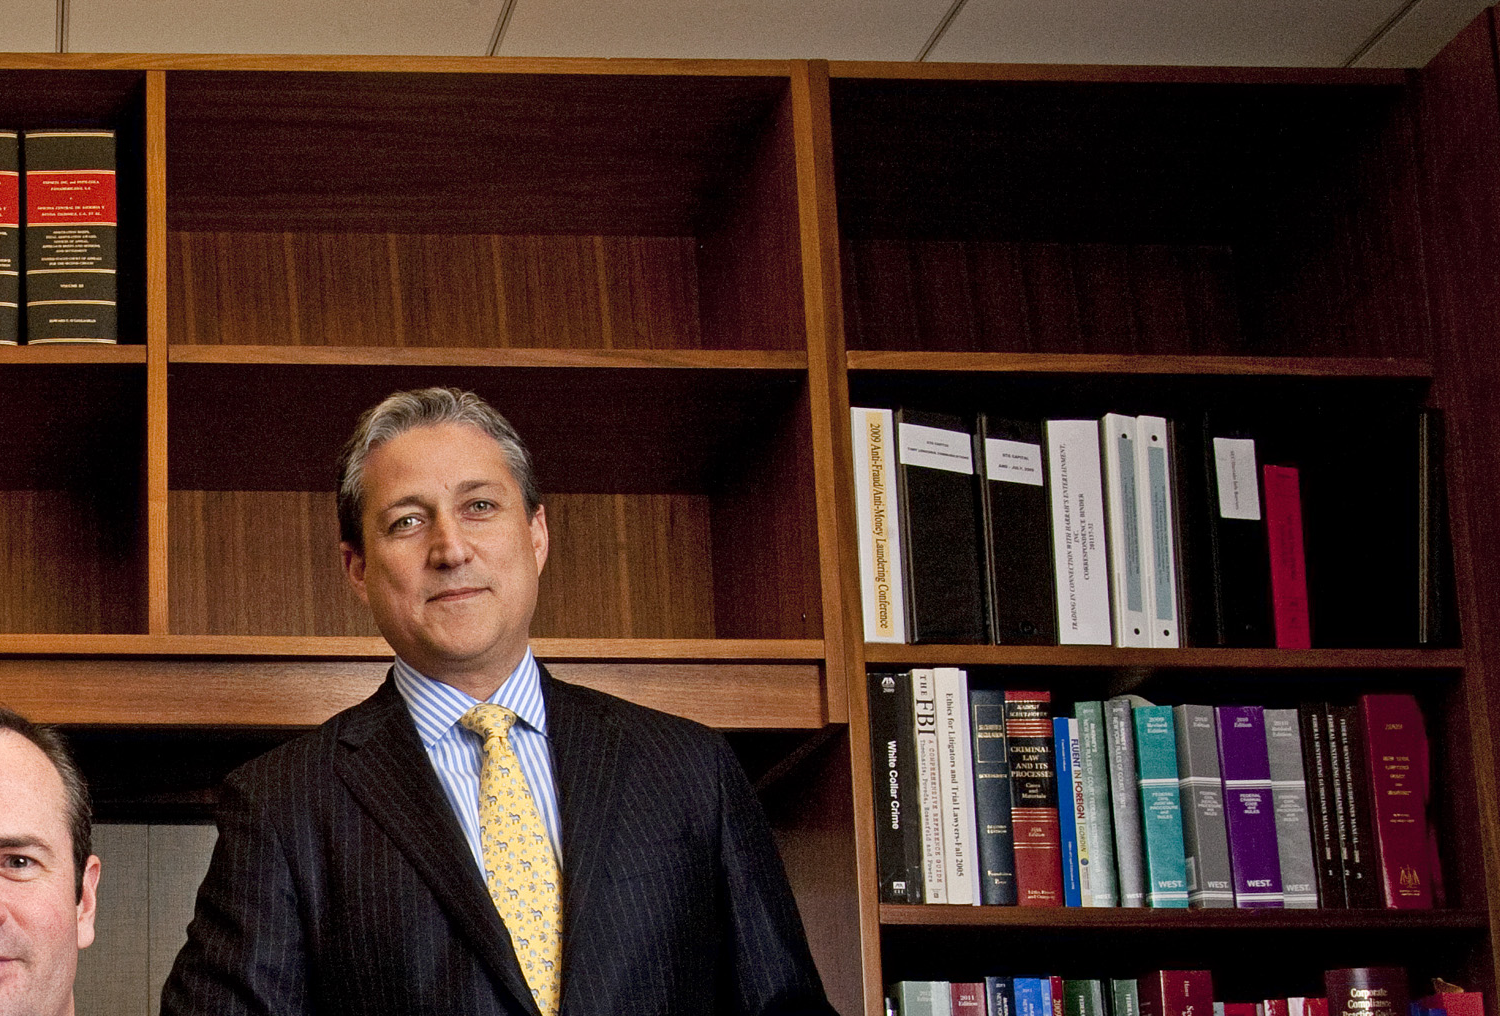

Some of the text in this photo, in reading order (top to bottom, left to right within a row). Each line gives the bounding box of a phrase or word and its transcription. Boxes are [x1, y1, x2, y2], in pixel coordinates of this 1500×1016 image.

[870, 423, 890, 629] 2009 Anti-Fraud/Anti-Money Laundering Conference
[1080, 519, 1090, 580] CORRESPONDENCE
[1067, 551, 1075, 592] CONNECTION
[1070, 602, 1078, 630] TRADING
[916, 675, 935, 736] THE FBI
[887, 741, 900, 829] White Collar Crime
[929, 748, 938, 809] COMPREHENSIVE
[946, 693, 964, 876] Ethics for Litigators and Trial Lawyers-Fall 2005
[1071, 739, 1085, 819] FLUENT IN FOREIGN
[1078, 826, 1087, 852] GORDIN
[1053, 999, 1062, 1016] 2009
[1348, 999, 1391, 1010] Compliance
[1350, 987, 1388, 999] Corporate
